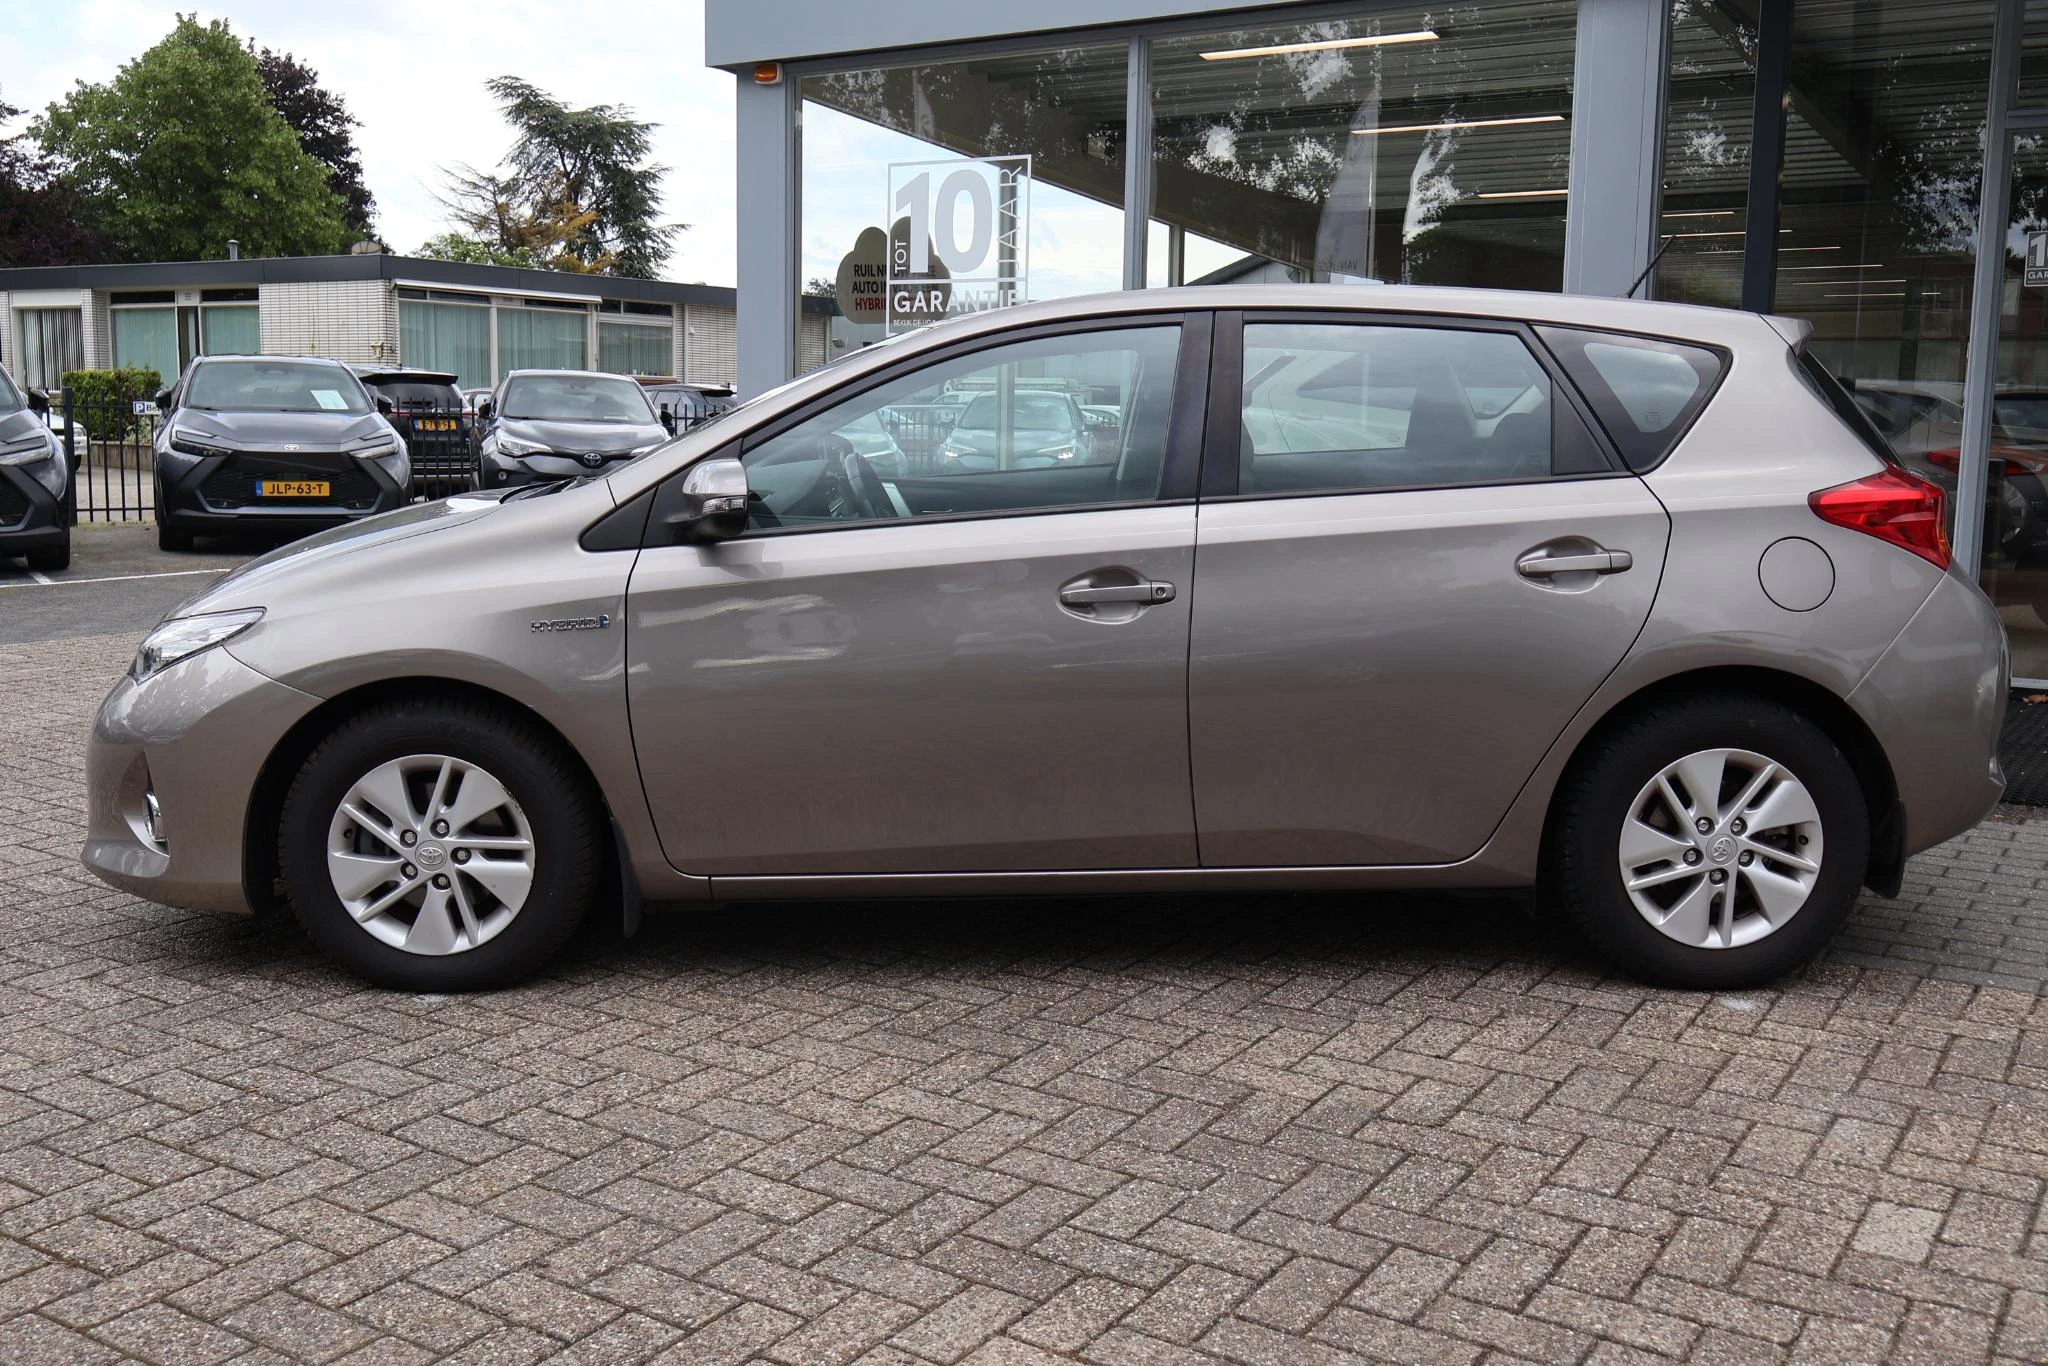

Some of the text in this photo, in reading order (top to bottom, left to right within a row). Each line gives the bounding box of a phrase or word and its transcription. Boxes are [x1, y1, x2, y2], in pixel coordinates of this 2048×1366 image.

[895, 169, 993, 273] 10
[996, 165, 1022, 271] JAAR
[894, 239, 907, 274] TOT
[2030, 233, 2048, 267] 1
[854, 263, 875, 277] RUIL
[852, 281, 879, 294] AUTO
[893, 289, 1019, 313] GARANTIE
[269, 483, 324, 495] JLP-63-T
[530, 617, 599, 632] HYBRID
